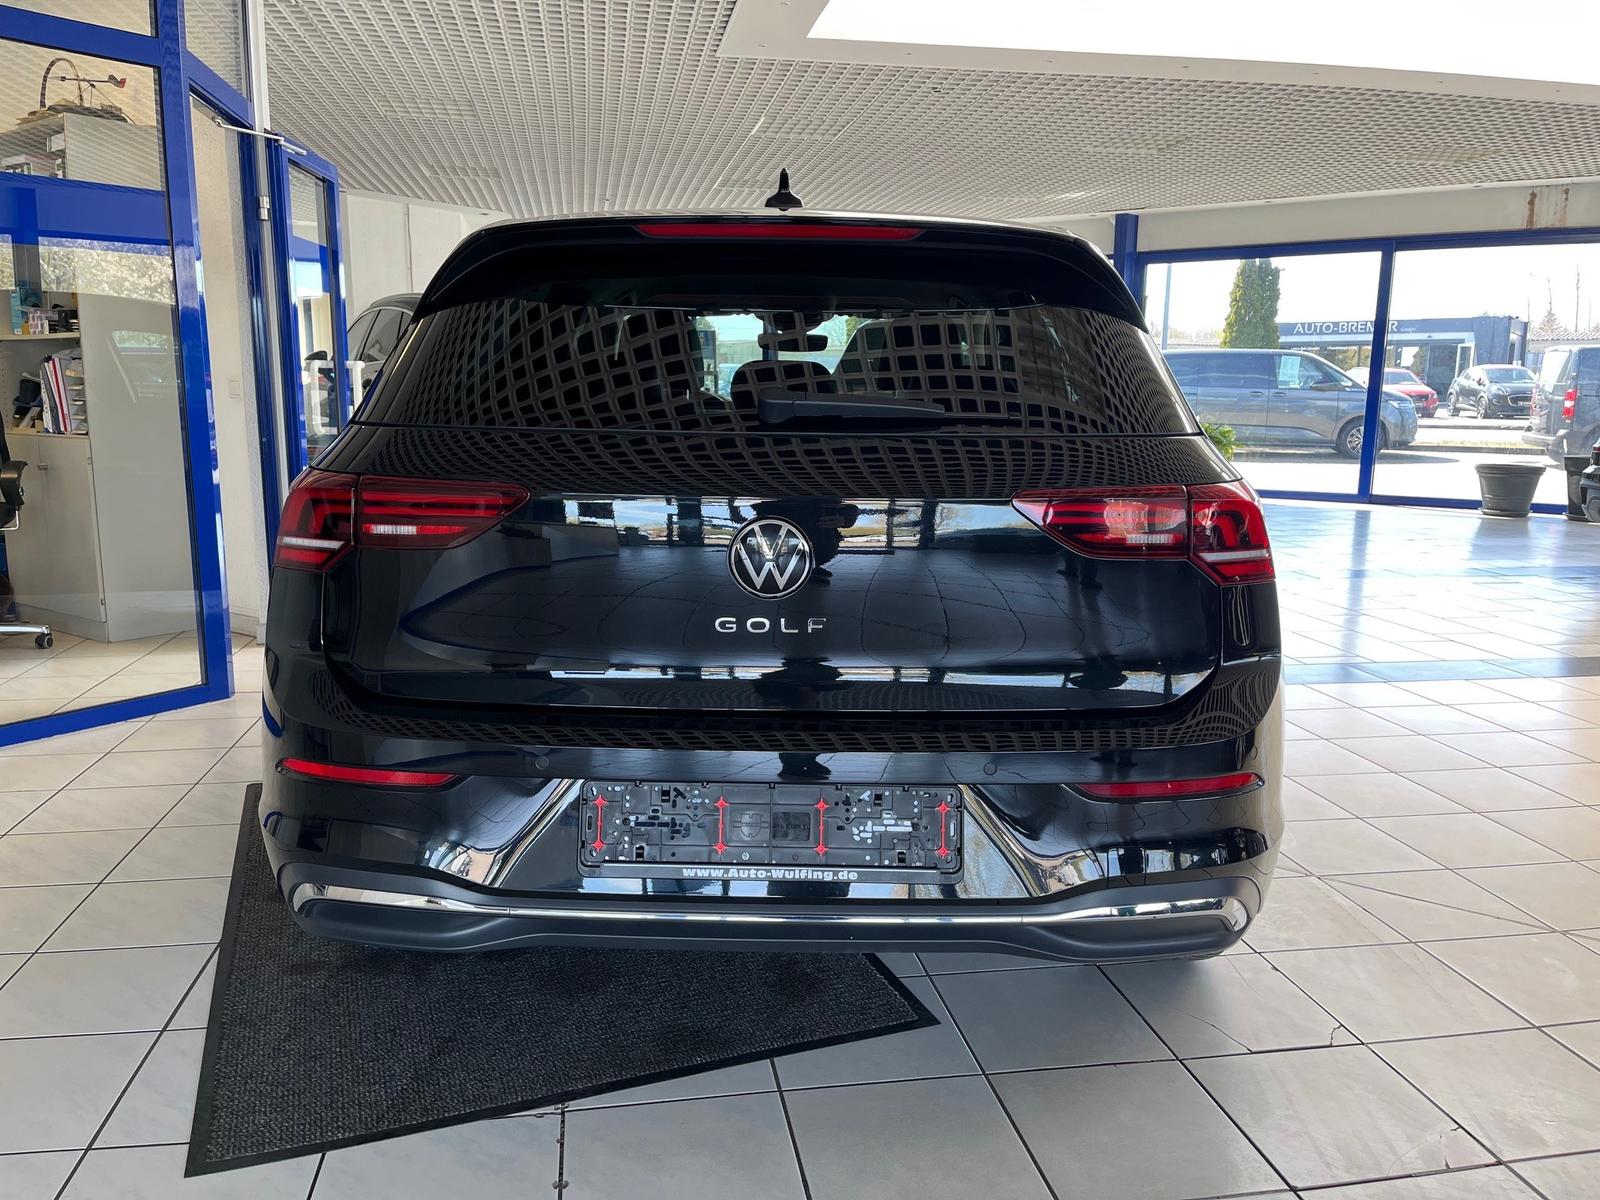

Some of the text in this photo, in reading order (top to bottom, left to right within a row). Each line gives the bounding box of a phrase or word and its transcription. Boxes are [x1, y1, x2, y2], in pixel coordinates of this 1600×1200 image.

[1293, 321, 1398, 334] AUTO-BREMR
[714, 617, 827, 633] GOLF
[682, 867, 859, 880] www.Auto-Wulfing.de
